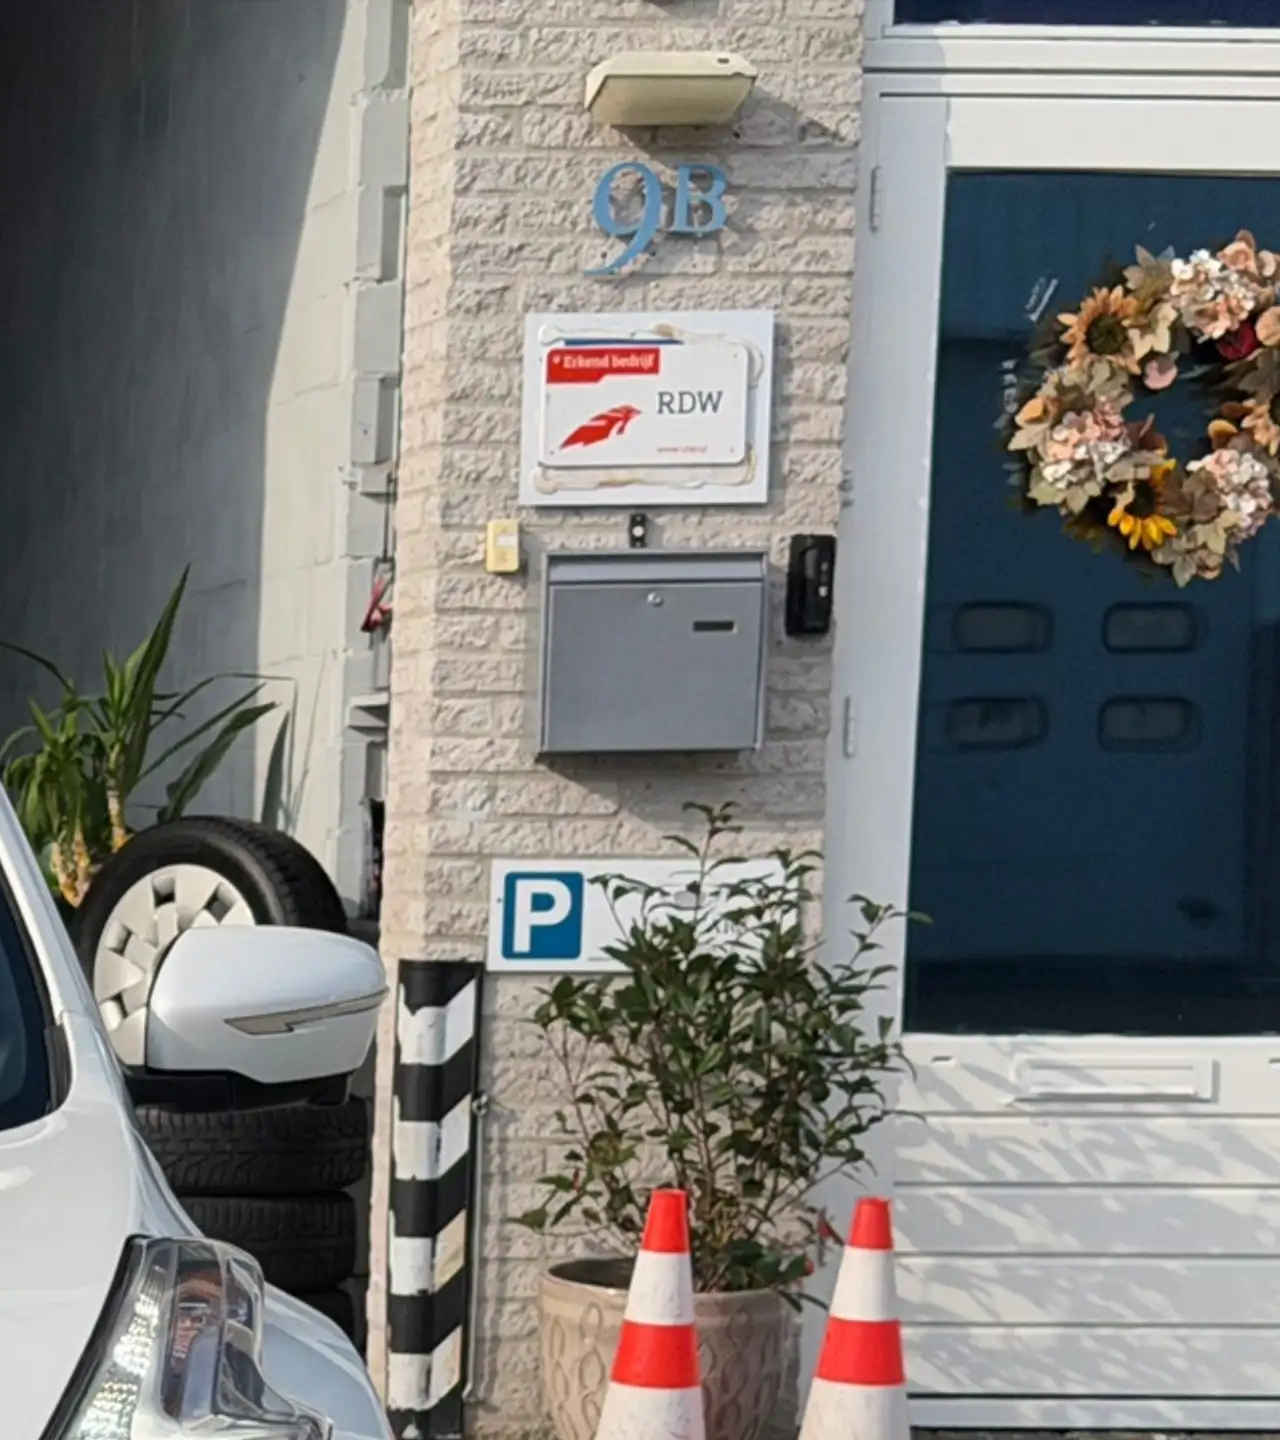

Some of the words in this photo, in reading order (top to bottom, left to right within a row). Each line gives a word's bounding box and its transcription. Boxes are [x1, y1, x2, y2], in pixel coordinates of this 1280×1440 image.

[584, 161, 729, 276] 9B
[563, 353, 609, 369] Erkend
[612, 353, 656, 371] bedrijf
[656, 391, 723, 415] RDW
